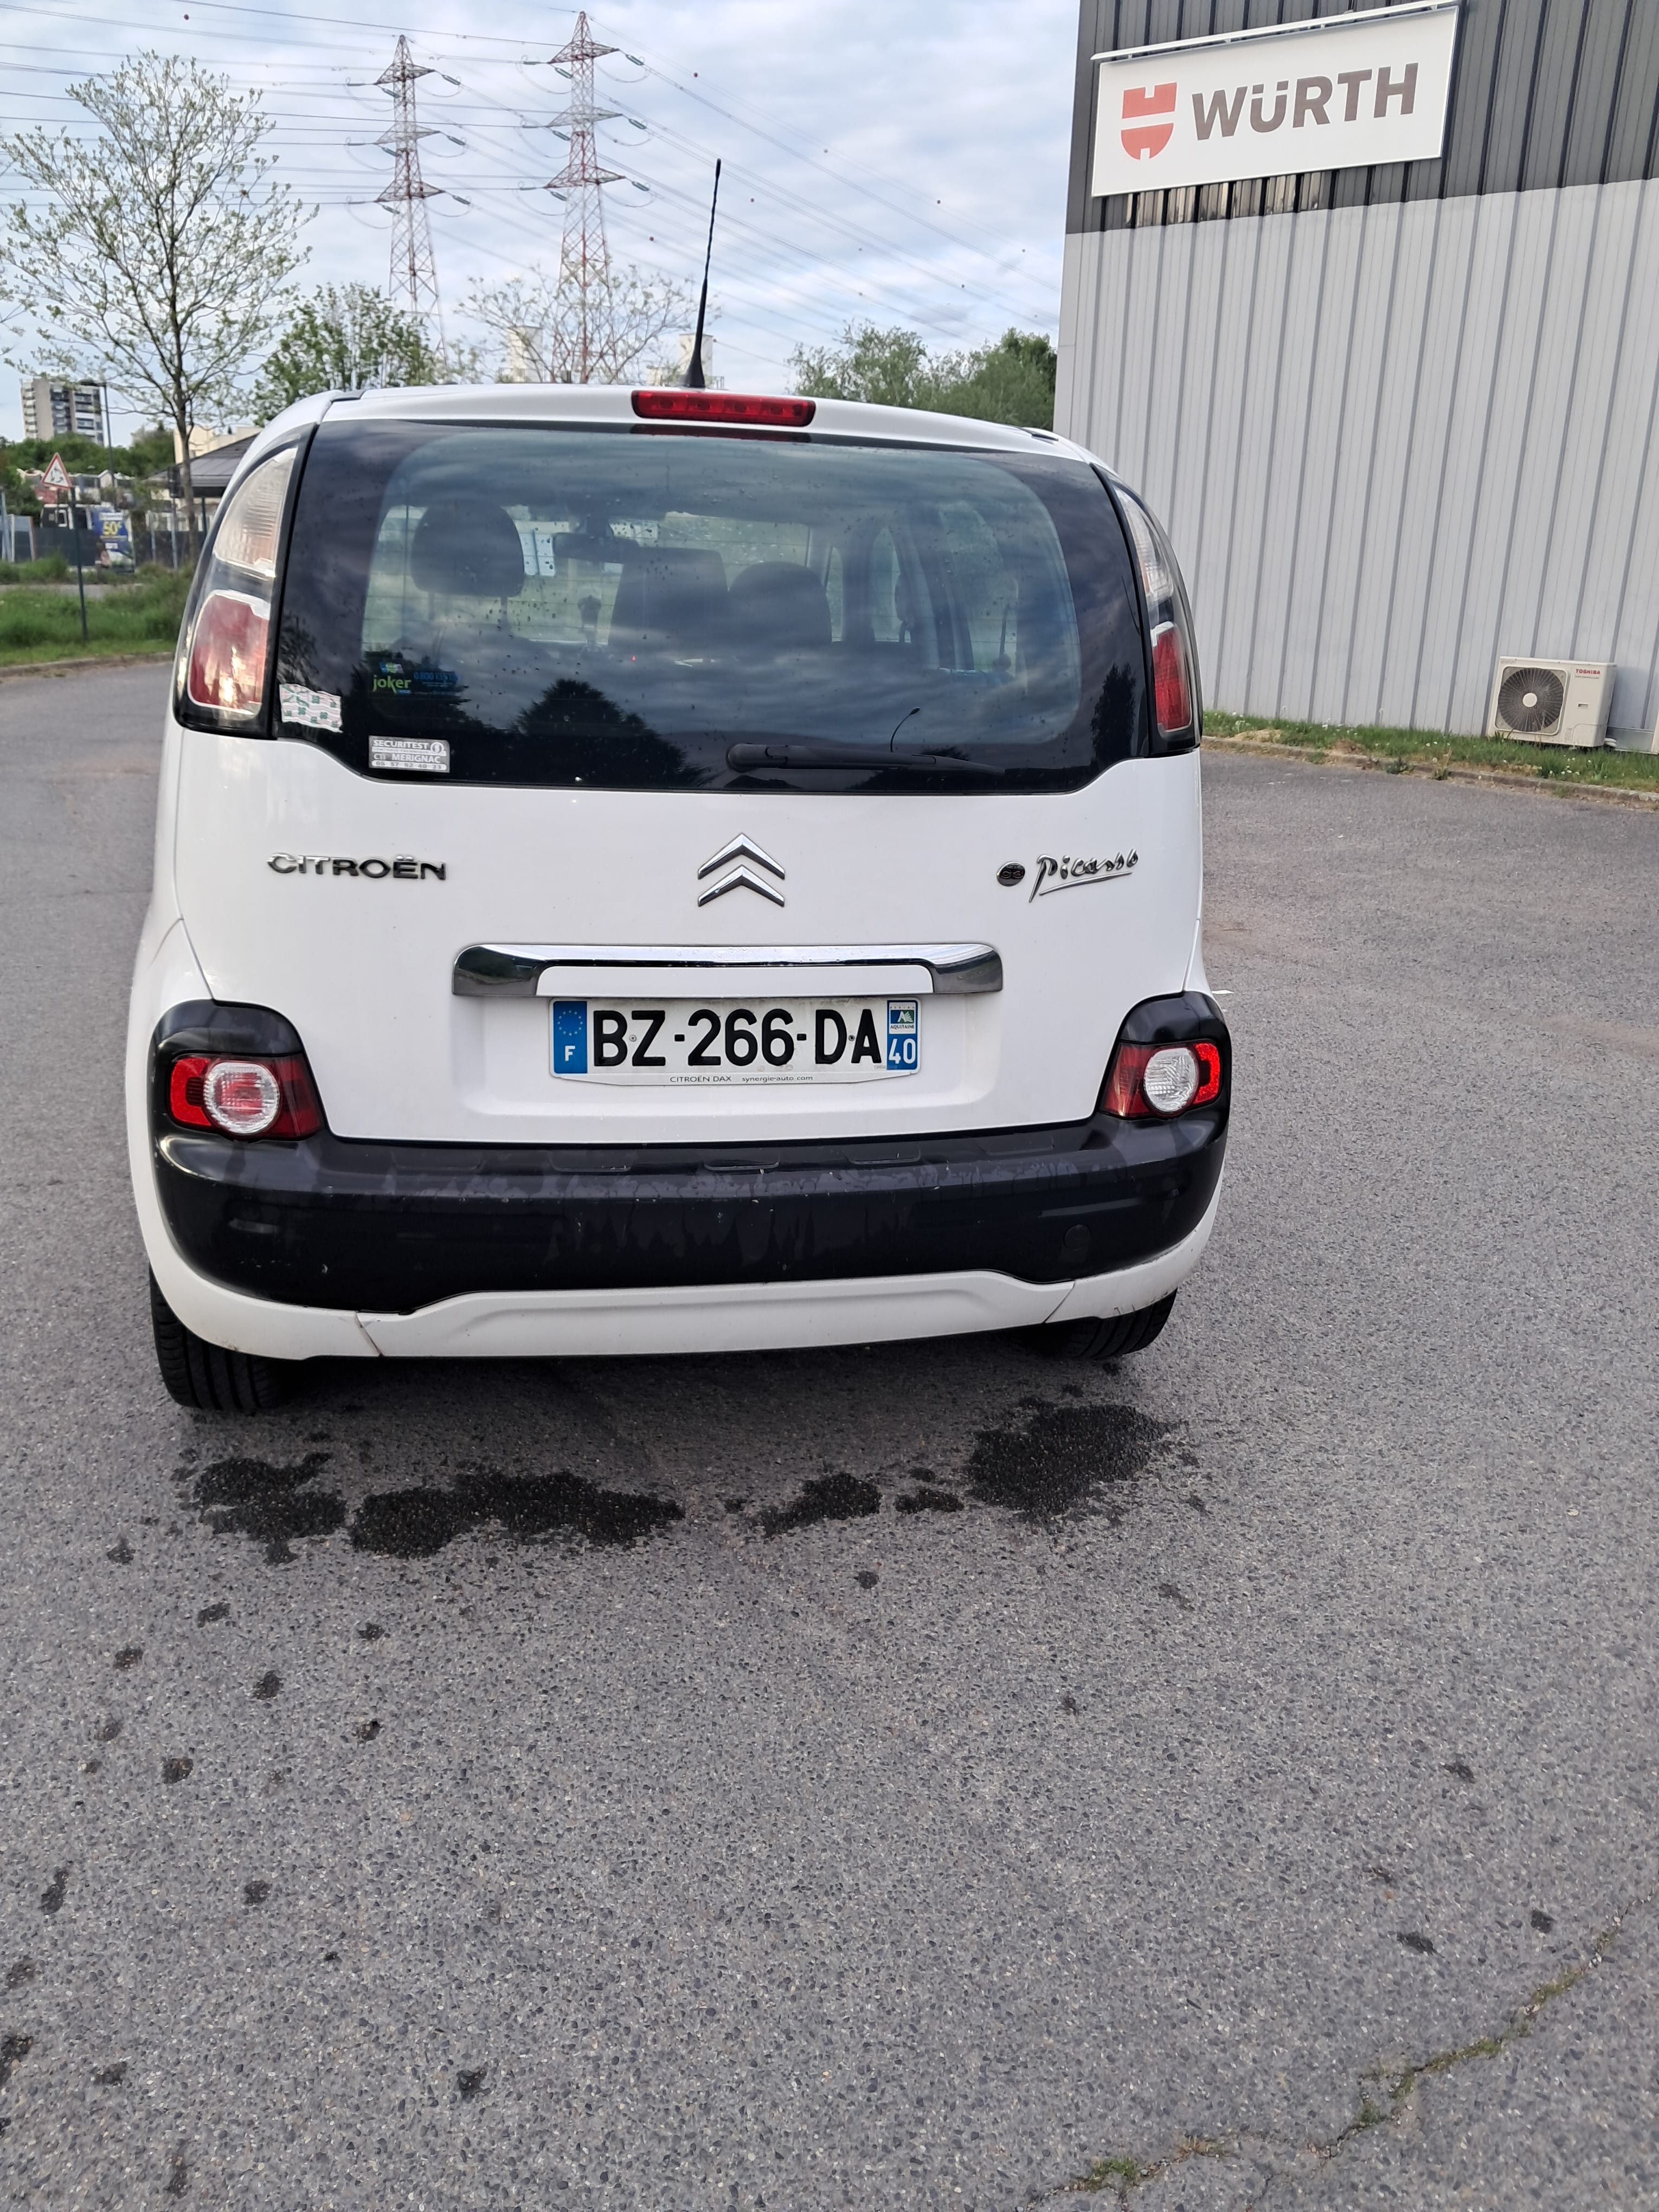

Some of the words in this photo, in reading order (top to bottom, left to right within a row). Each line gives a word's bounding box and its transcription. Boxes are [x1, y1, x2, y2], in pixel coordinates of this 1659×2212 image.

[1192, 62, 1418, 140] WÜRTH
[373, 674, 411, 693] joker
[373, 740, 429, 749] SECURITEST
[391, 754, 441, 763] MERIGNAC
[267, 853, 446, 880] CITROËN
[1029, 848, 1139, 903] Picasso
[594, 1008, 882, 1066] BZ-266-DA
[565, 1046, 575, 1061] F
[889, 1038, 916, 1064] 40
